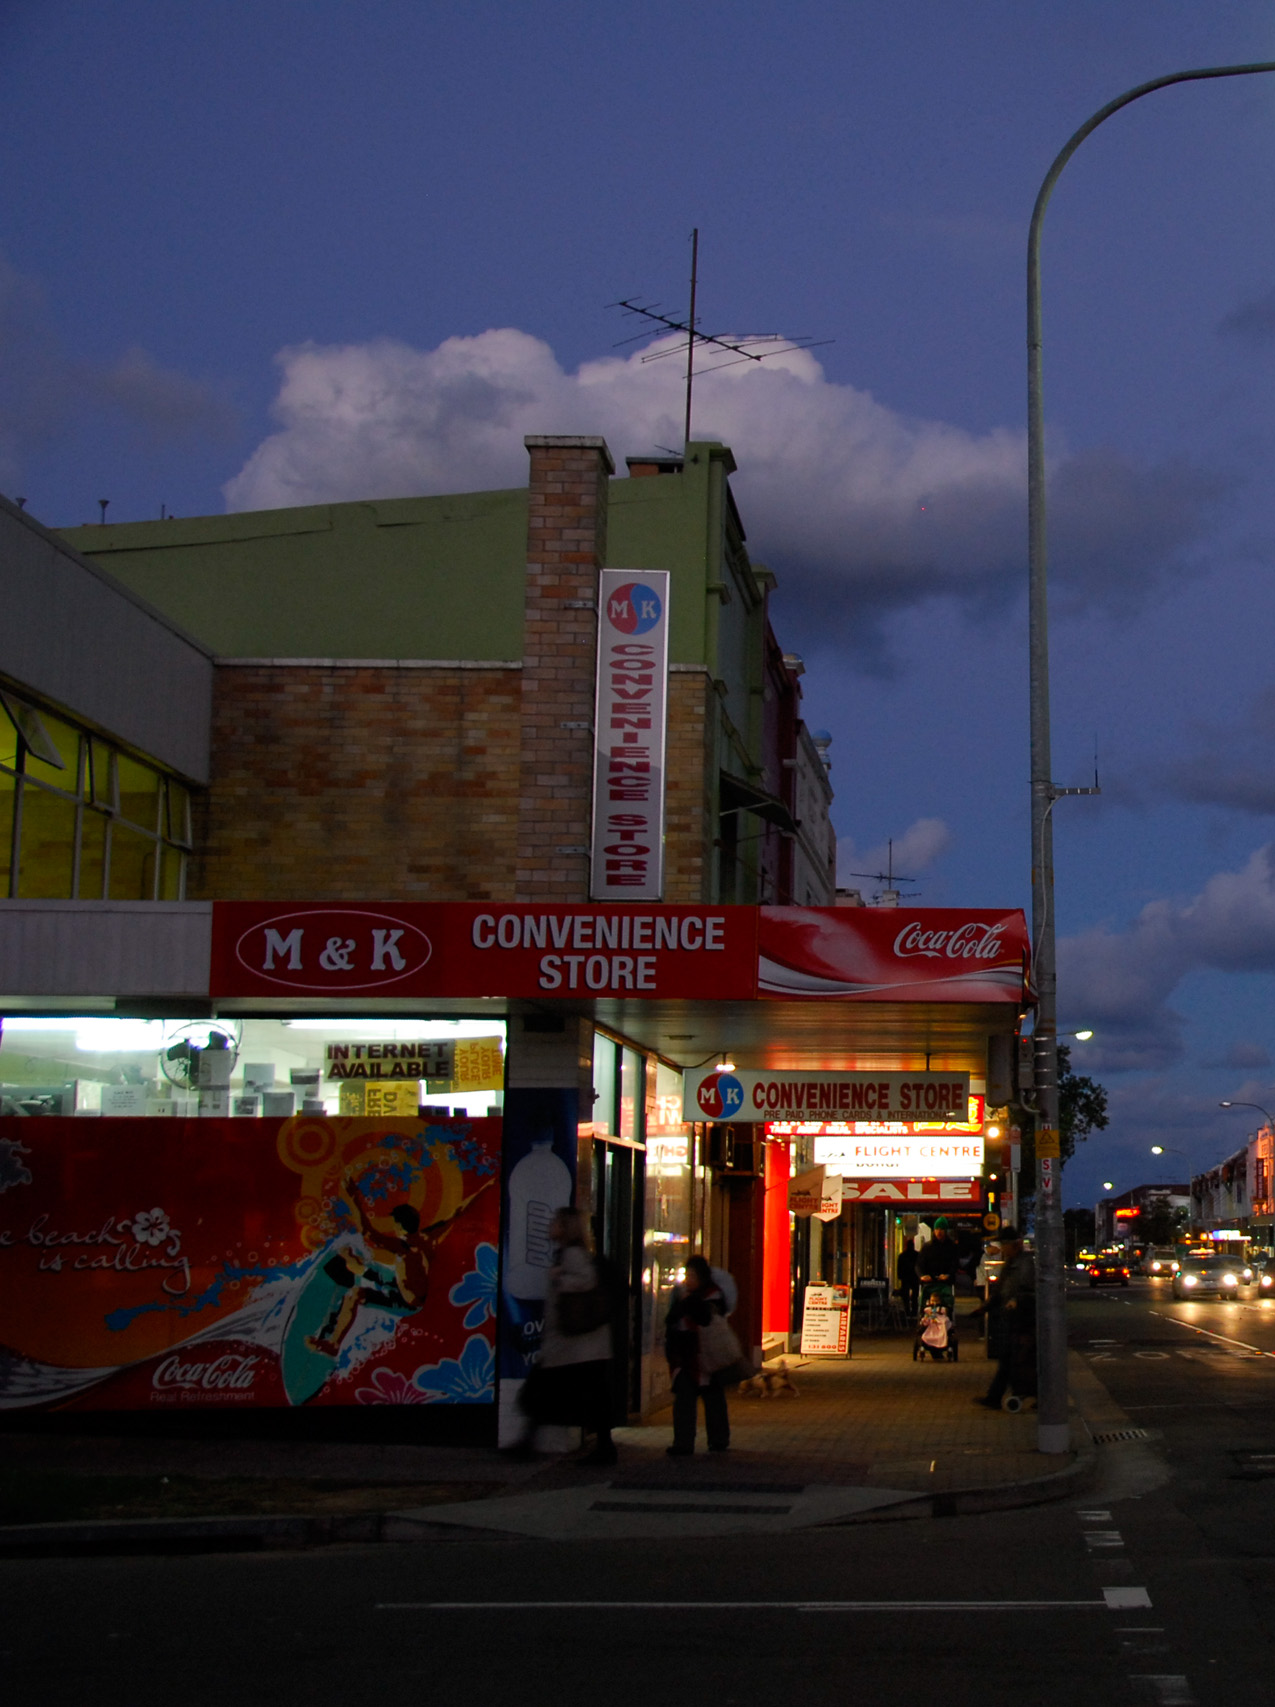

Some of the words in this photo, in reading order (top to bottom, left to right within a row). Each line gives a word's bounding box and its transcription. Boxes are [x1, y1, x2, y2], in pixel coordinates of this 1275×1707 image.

[611, 600, 628, 619] M
[641, 600, 657, 619] K
[607, 644, 656, 801] CONVENIENCE
[603, 814, 650, 886] STORE
[471, 913, 725, 951] CONVENIENCE
[893, 921, 1009, 959] Coca-Cola
[262, 928, 304, 971] M
[319, 936, 357, 972] &
[370, 928, 407, 972] K
[538, 954, 658, 991] STORE
[327, 1042, 449, 1060] INTERNET
[327, 1061, 450, 1080] AVAILABLE
[700, 1087, 716, 1105] M
[726, 1087, 741, 1105] K
[752, 1081, 890, 1110] CONVENIENCE
[899, 1082, 964, 1111] STORE
[763, 1110, 781, 1119] PRE
[785, 1110, 805, 1119] PAID
[809, 1110, 838, 1119] PHONE
[842, 1110, 872, 1119] CARDS
[876, 1110, 883, 1119] &
[855, 1146, 911, 1157] FLIGHT
[919, 1146, 981, 1157] CENTRE
[841, 1182, 973, 1199] SALE
[26, 1212, 126, 1246] beach
[38, 1248, 68, 1273] is
[73, 1243, 192, 1296] calling
[839, 1311, 847, 1351] AIRFARES
[152, 1354, 262, 1390] Coca-Cola
[150, 1391, 178, 1402] Real
[181, 1391, 256, 1402] Refreshment
